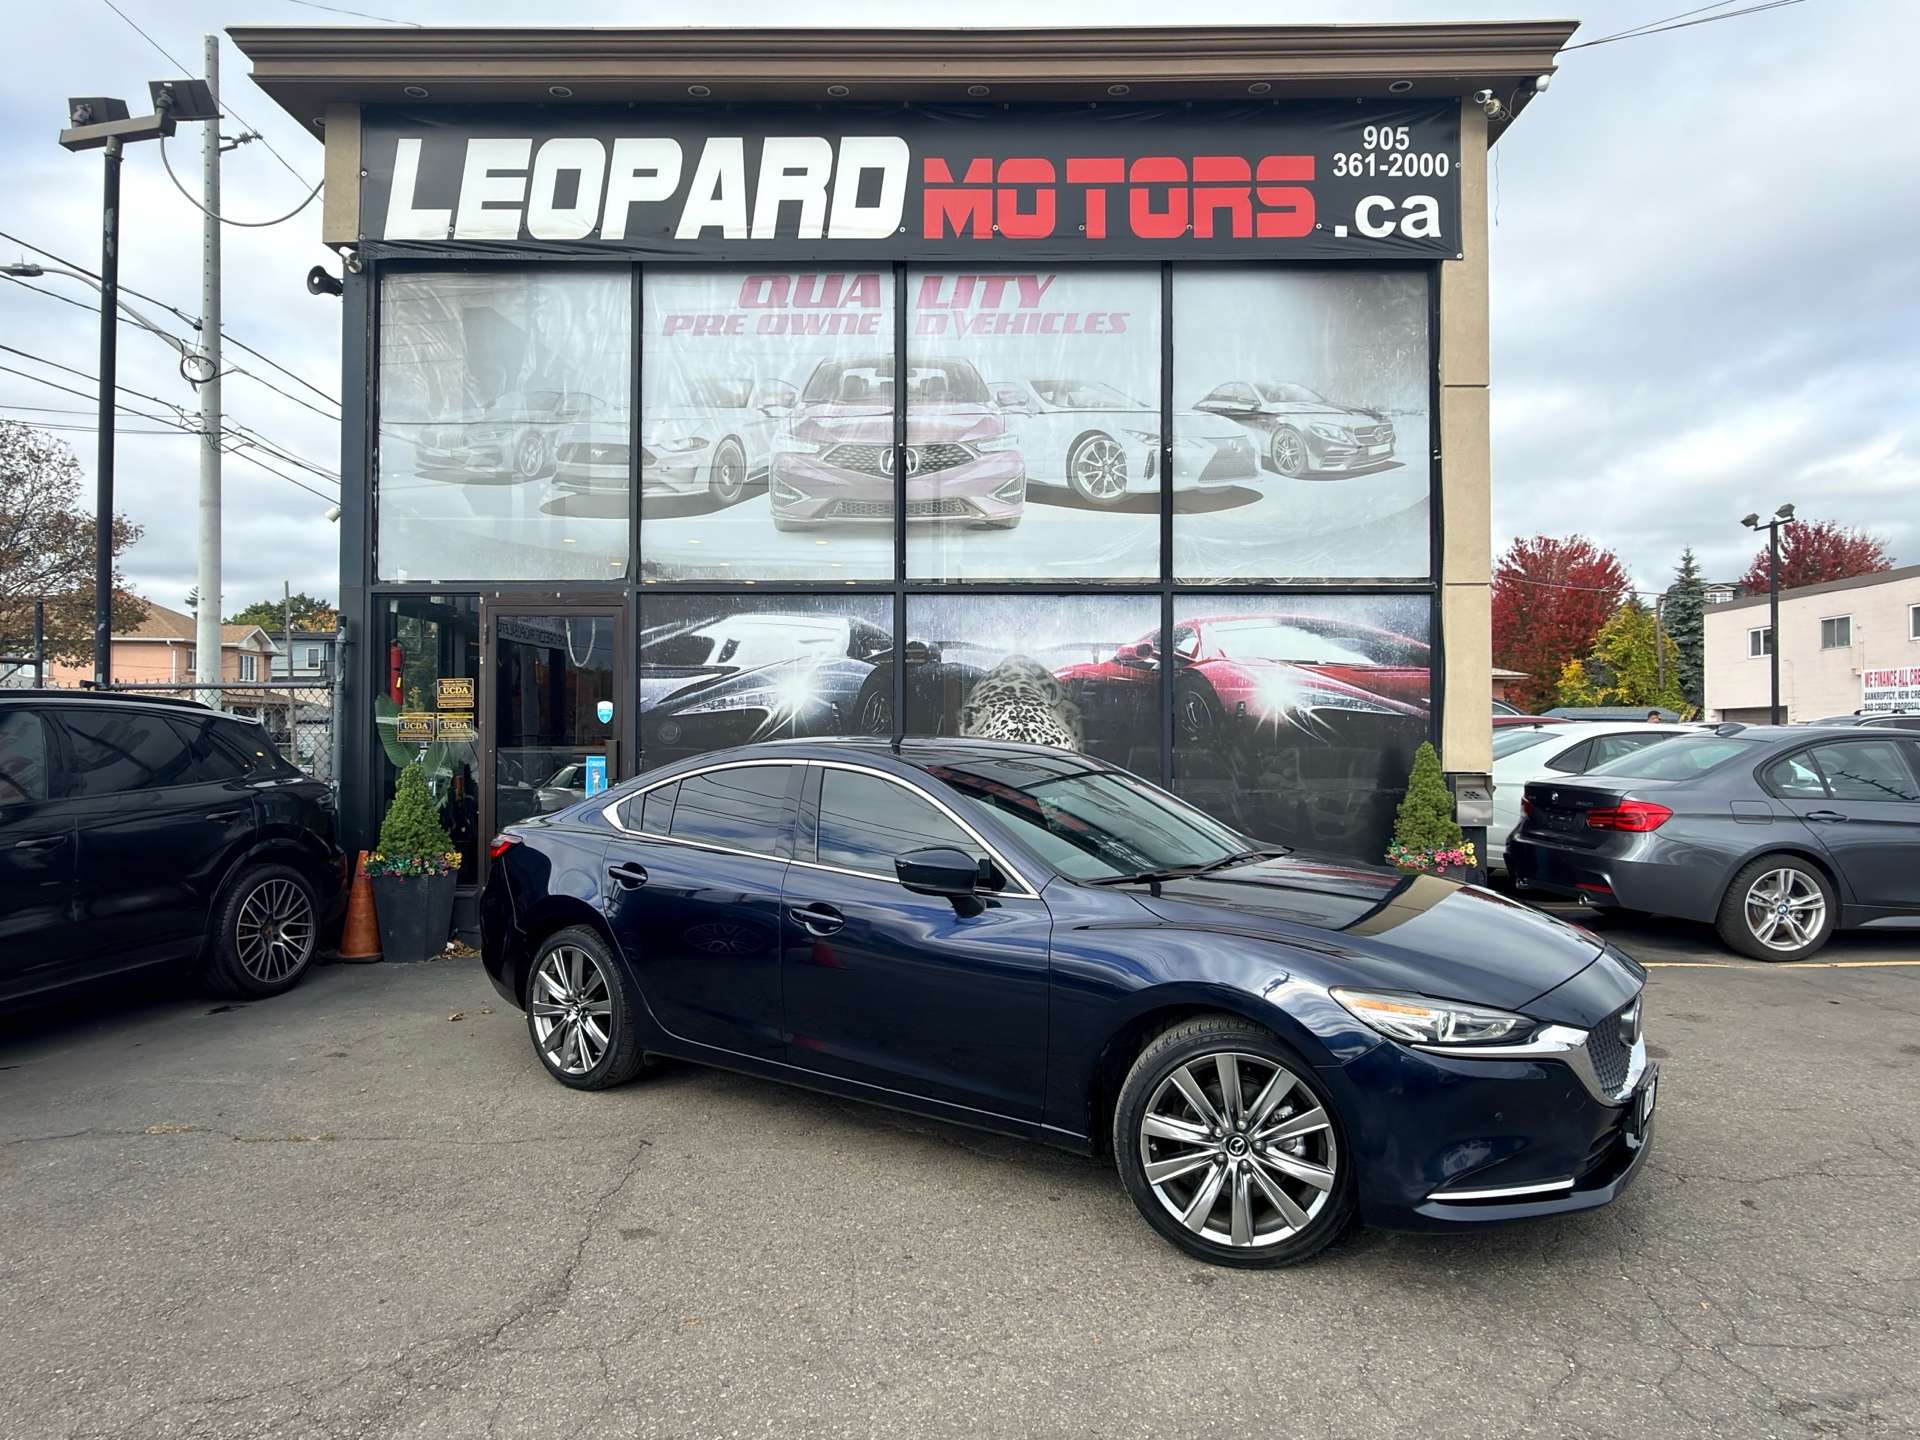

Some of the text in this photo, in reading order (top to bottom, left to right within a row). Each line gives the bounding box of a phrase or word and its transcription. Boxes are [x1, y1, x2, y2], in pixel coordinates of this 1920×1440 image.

[1363, 125, 1410, 150] 905
[1332, 152, 1449, 177] 361-2000
[384, 136, 1442, 240] LEOPARD MOTORS .ca
[662, 314, 748, 337] PRE
[442, 686, 469, 694] UCDA
[1864, 672, 1873, 688] WE
[1874, 670, 1897, 687] FINANCE
[1898, 669, 1909, 687] ALL
[1898, 690, 1909, 700] NEW
